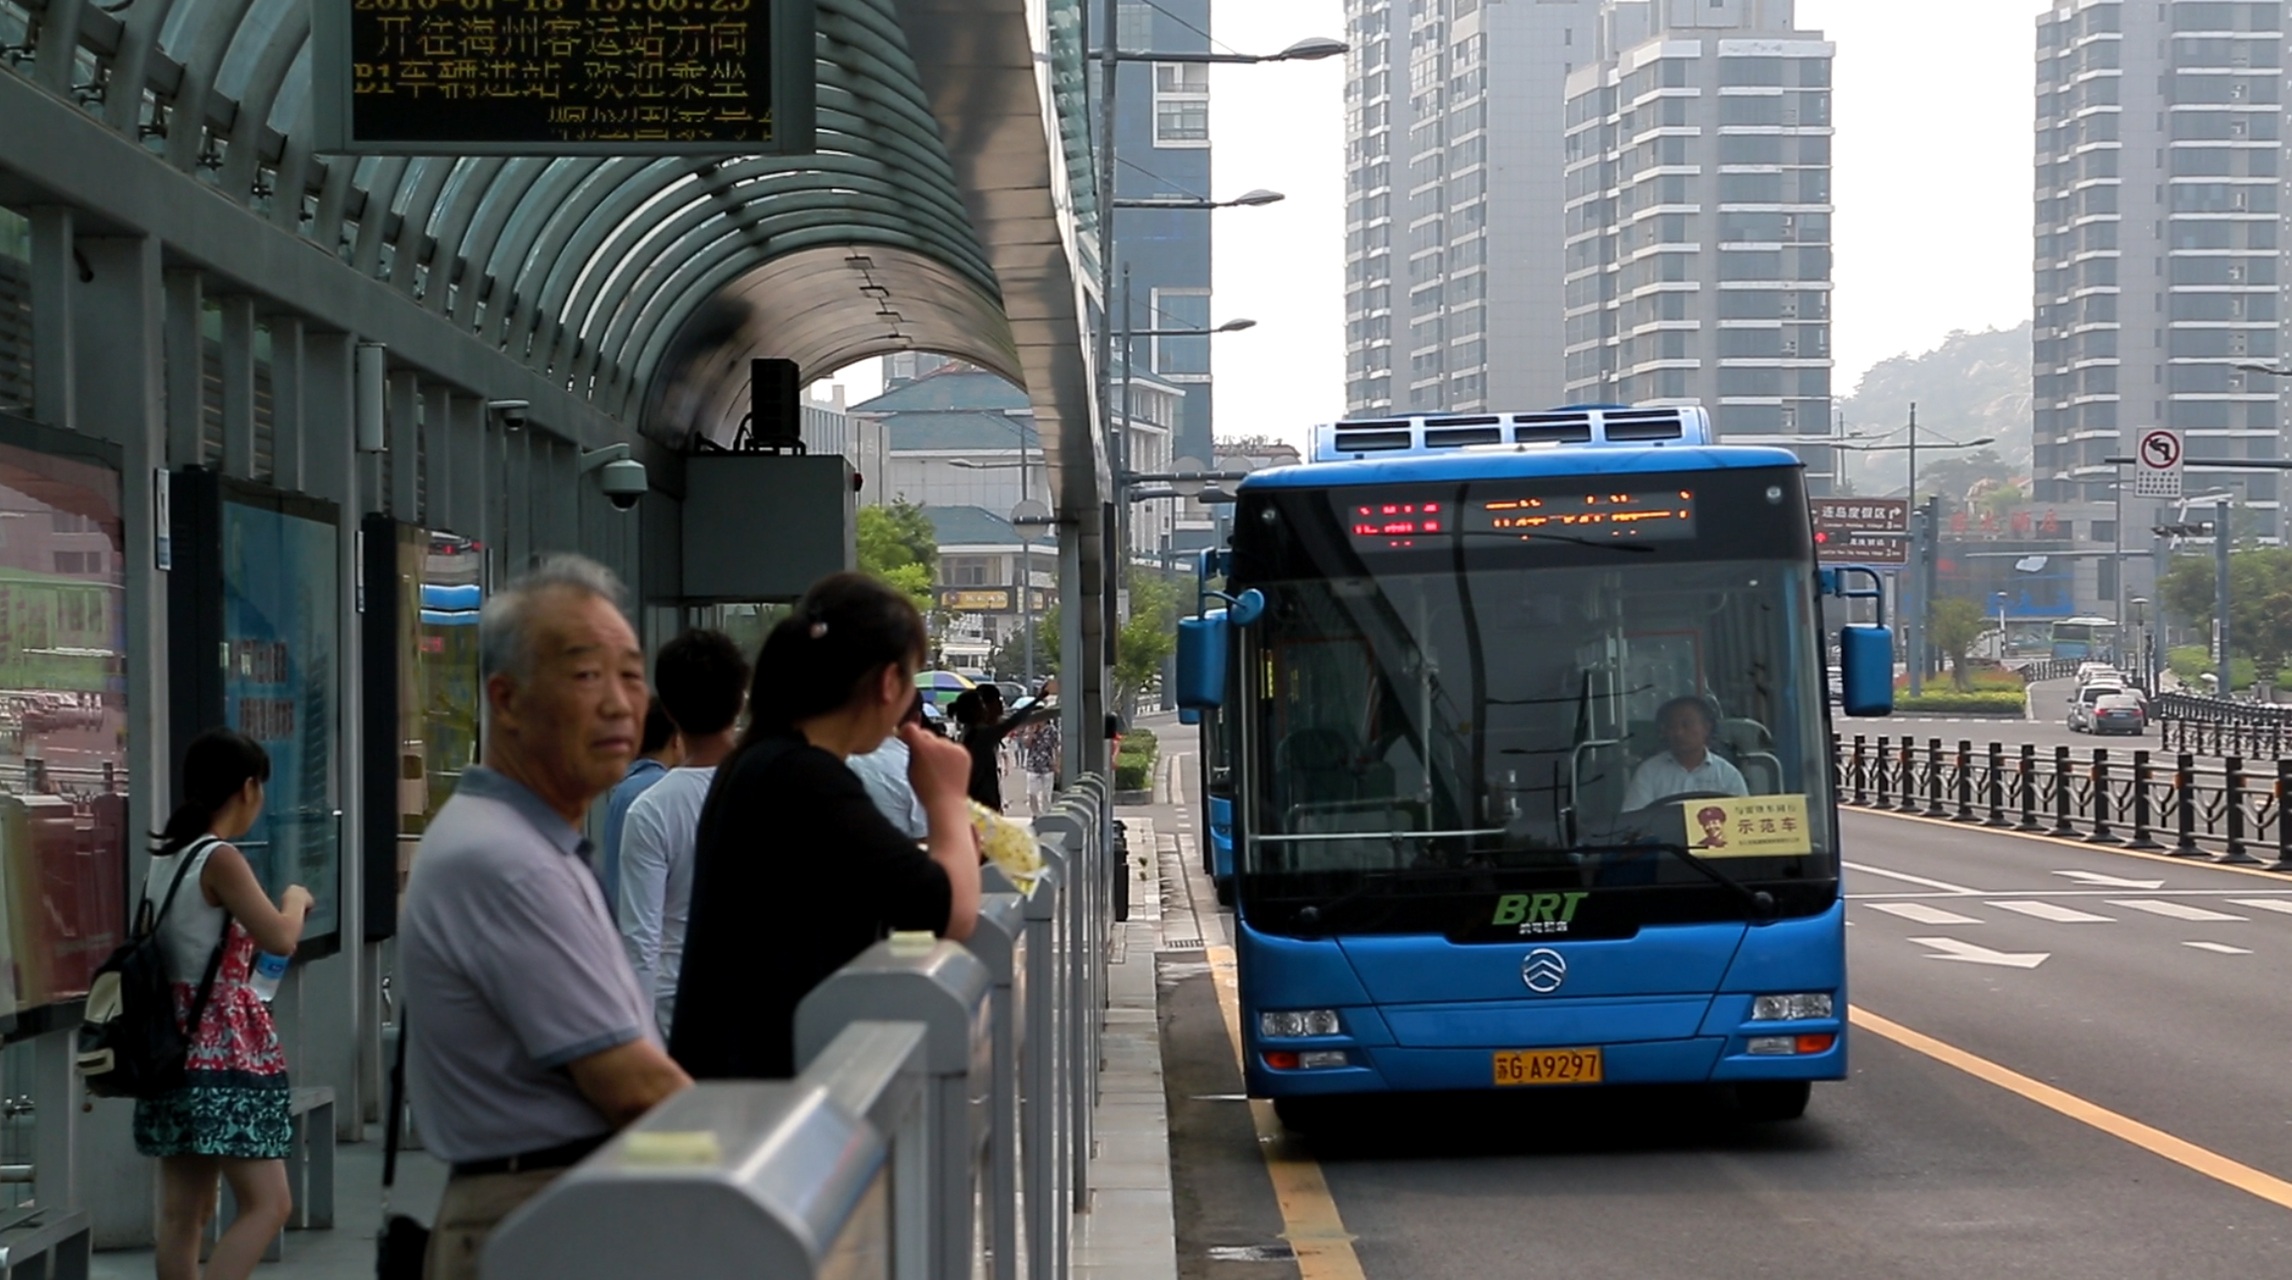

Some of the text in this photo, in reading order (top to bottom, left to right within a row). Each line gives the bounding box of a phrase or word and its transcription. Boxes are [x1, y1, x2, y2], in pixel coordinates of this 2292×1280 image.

[377, 15, 748, 57] 开往海州客运站方向
[1737, 816, 1798, 834] 示范车
[1492, 892, 1589, 925] BRT
